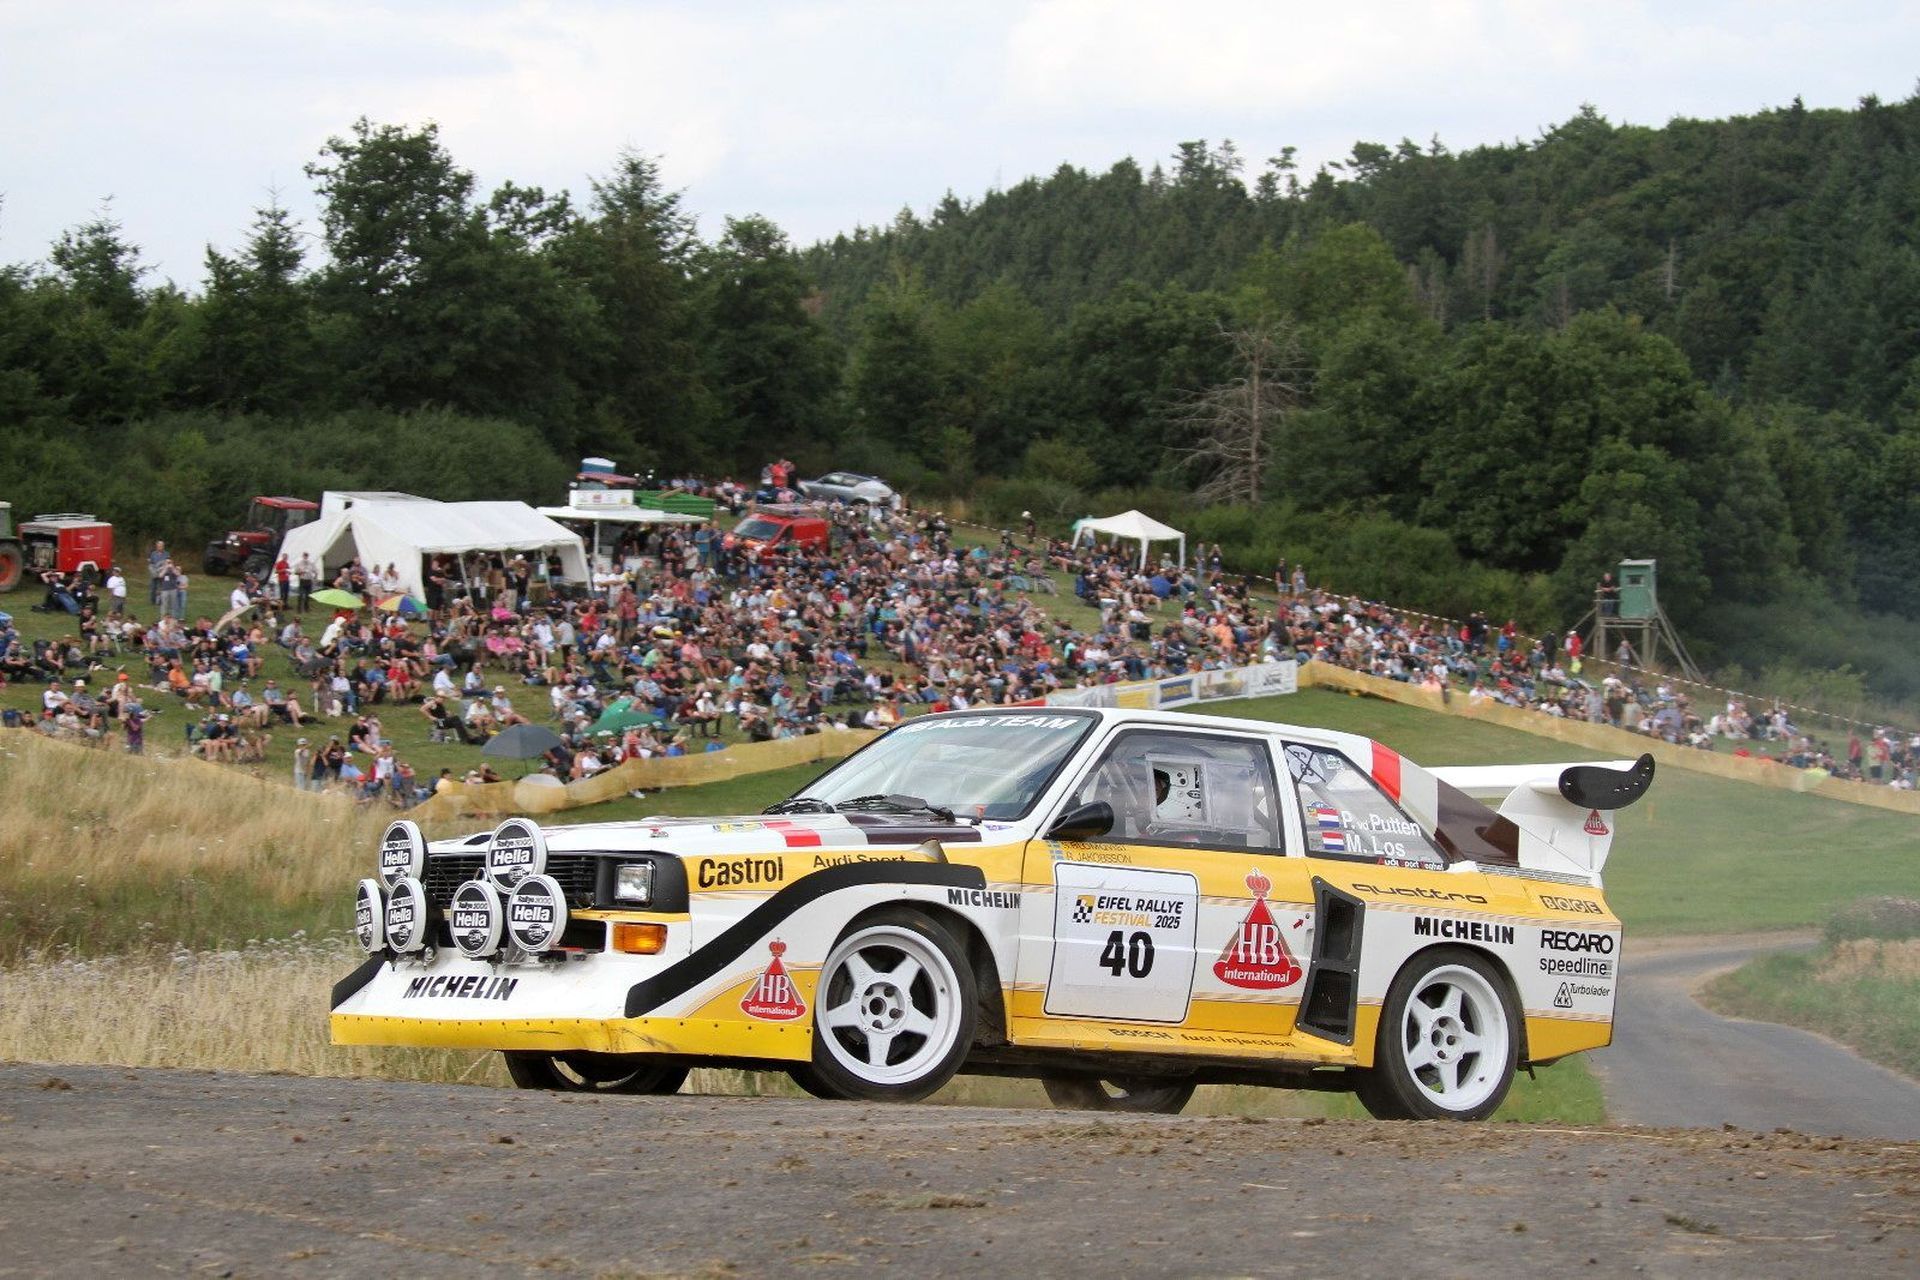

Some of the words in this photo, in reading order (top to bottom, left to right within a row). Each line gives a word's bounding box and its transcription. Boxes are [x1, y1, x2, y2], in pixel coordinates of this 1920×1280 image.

[989, 715, 1078, 729] TEAM
[1341, 810, 1355, 829] P.
[1369, 813, 1421, 837] Putten
[1346, 834, 1367, 853] M.
[1371, 836, 1406, 857] Los
[384, 850, 409, 866] Hella
[493, 848, 531, 866] Hella
[813, 854, 852, 869] Audi
[698, 856, 783, 888] Castrol
[947, 888, 1021, 909] MICHELIN
[1352, 883, 1487, 904] quattro
[514, 905, 550, 921] Hella
[1097, 896, 1132, 911] EIFEL
[1135, 899, 1183, 914] RALLYE
[389, 907, 412, 925] Hella
[455, 912, 487, 927] Hella
[1094, 911, 1152, 927] FESTIVAL
[1154, 915, 1181, 929] 2025
[1414, 916, 1514, 944] MICHELIN
[1238, 923, 1280, 966] HB
[1540, 929, 1613, 954] RECARO
[1099, 930, 1155, 978] 40
[1224, 966, 1290, 983] international
[1540, 957, 1607, 975] speedline
[402, 975, 519, 1000] MICHELIN
[758, 973, 790, 1004] HB
[1570, 983, 1610, 997] Turbolader
[748, 1004, 798, 1015] international
[1108, 1028, 1174, 1040] BOSCH
[1181, 1033, 1215, 1042] fuel
[1218, 1036, 1296, 1048] injection
